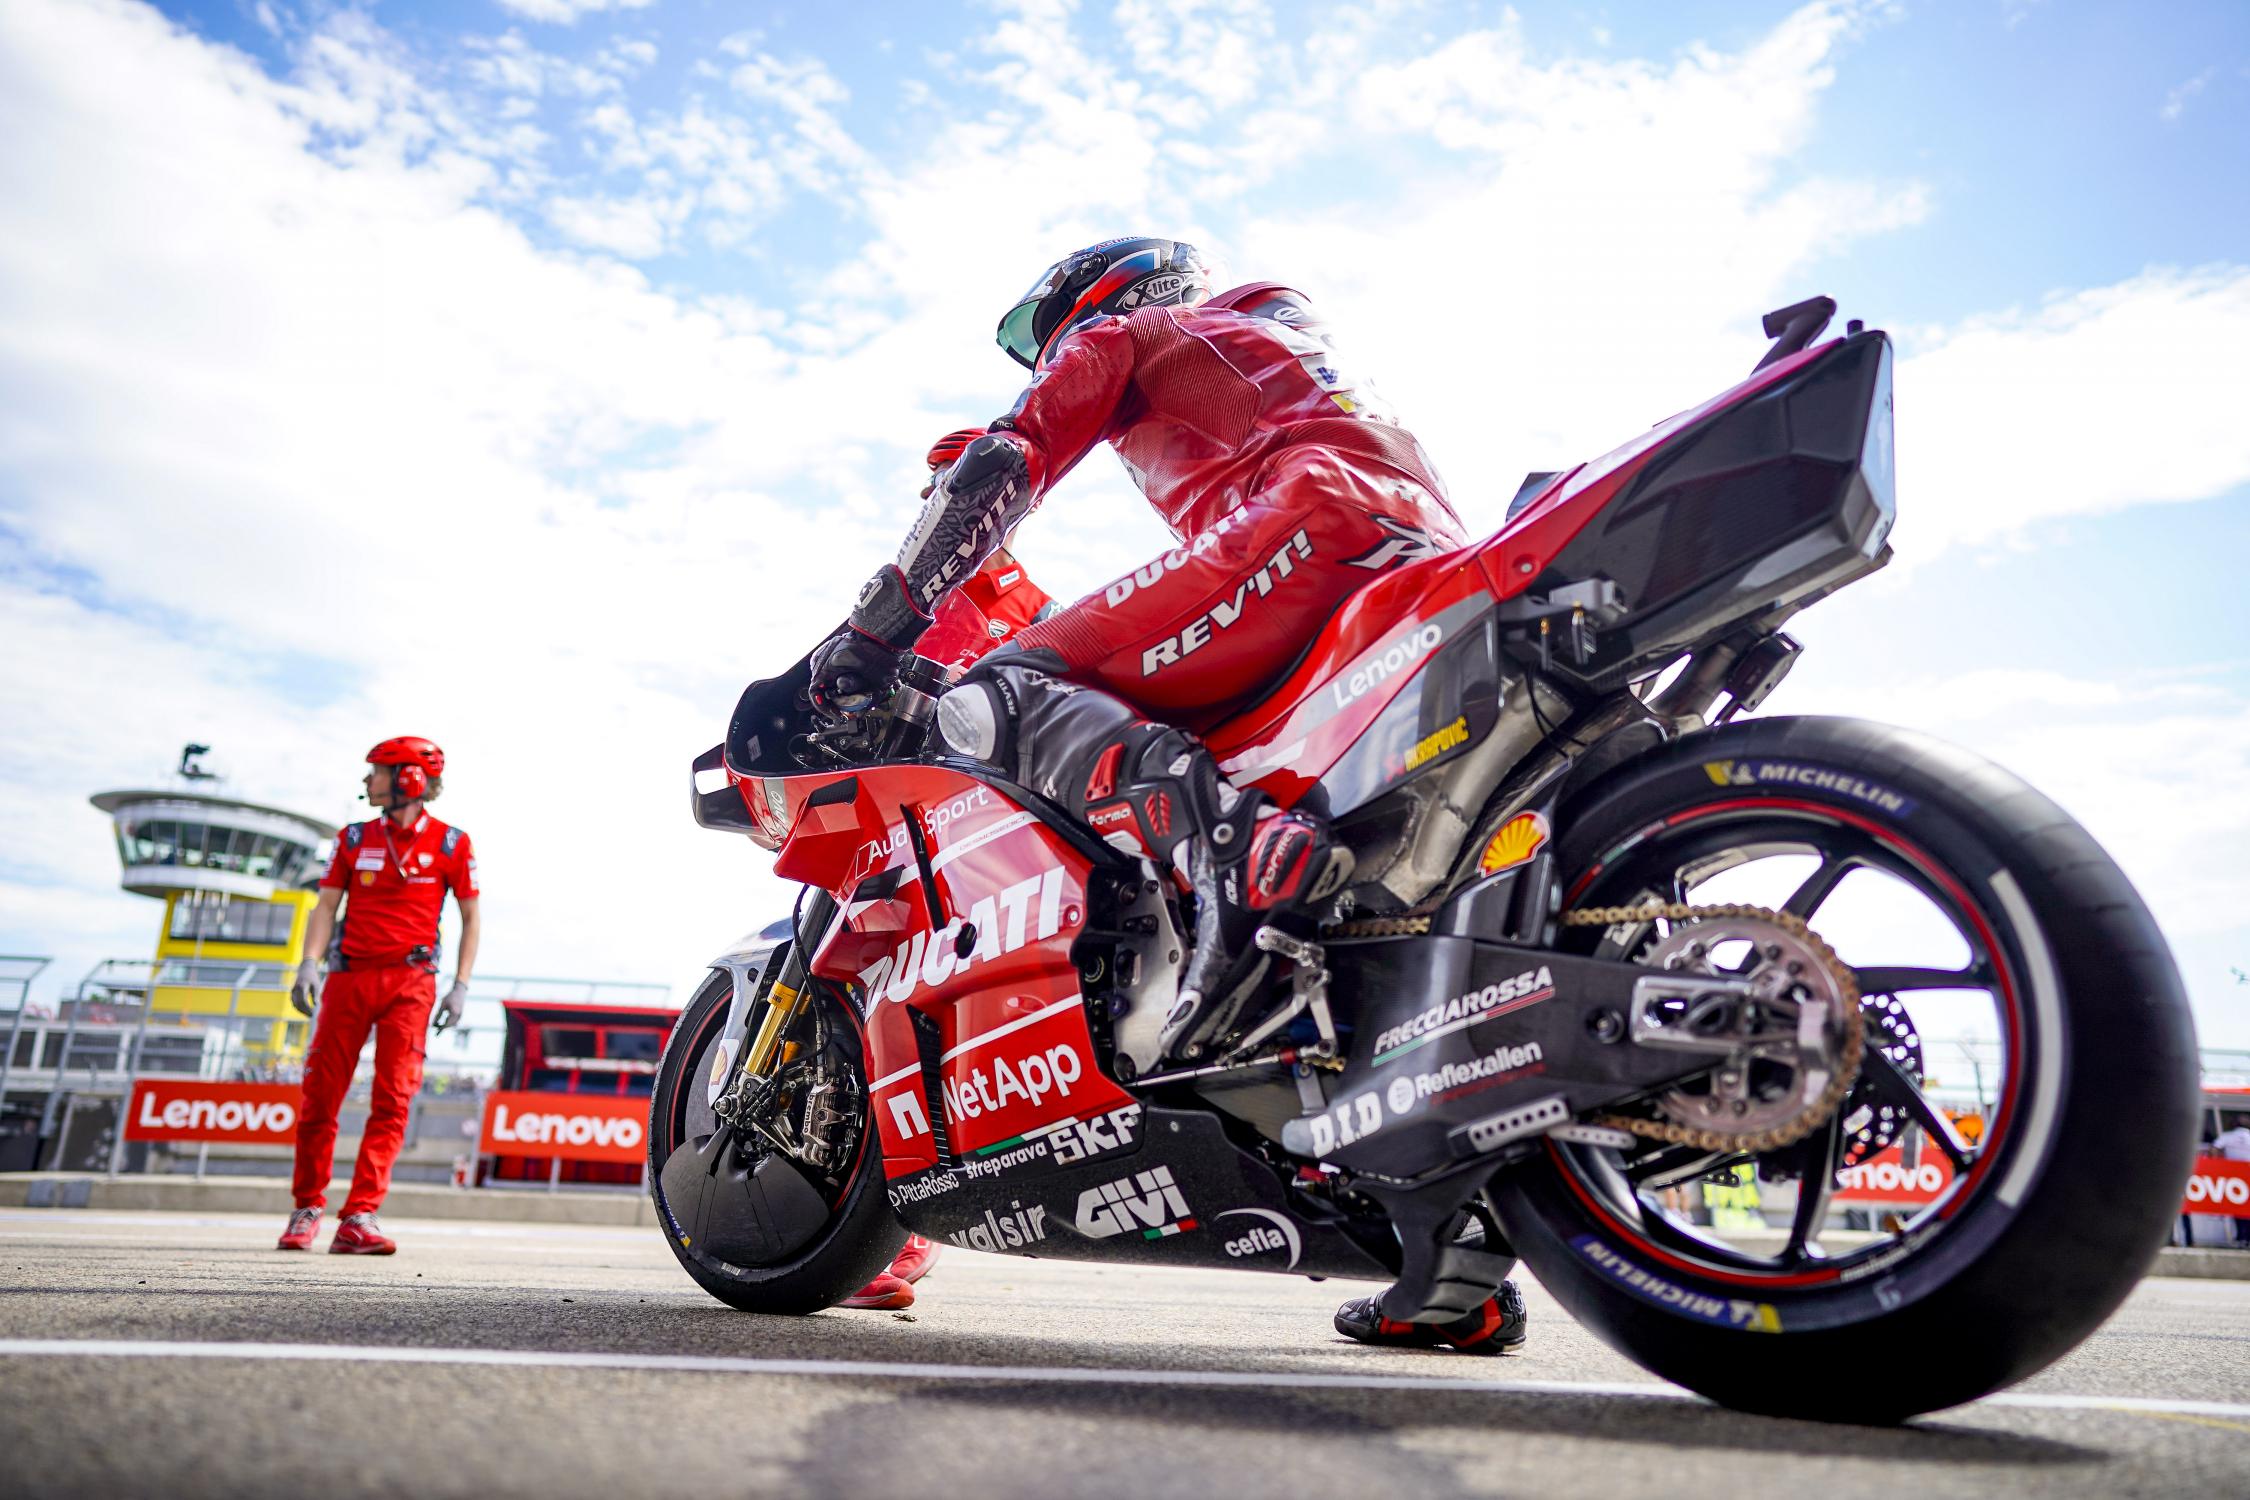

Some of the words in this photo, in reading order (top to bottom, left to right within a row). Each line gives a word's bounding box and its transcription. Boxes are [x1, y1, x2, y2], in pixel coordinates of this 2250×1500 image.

[1131, 277, 1180, 308] X-lite
[1105, 505, 1249, 609] DUCATI
[1332, 624, 1443, 709] Lenovo
[924, 785, 989, 837] Sport
[1758, 763, 1905, 812] MICHELIN
[857, 865, 1066, 1023] DUCATI
[1374, 965, 1553, 1055] FRECCIAROSSA
[940, 1043, 1082, 1126] NetApp
[1414, 1041, 1543, 1099] Reflexallen
[139, 1091, 296, 1133] Lenovo
[492, 1104, 643, 1148] Lenovo
[803, 1092, 816, 1134] brembo
[1047, 1103, 1142, 1166] SKF
[965, 1140, 1048, 1180] streparava
[1075, 1164, 1191, 1239] GIVI
[2185, 1174, 2249, 1205] ovo
[949, 1200, 1046, 1253] valsir
[1224, 1228, 1287, 1258] cefla
[1583, 1241, 1725, 1318] MICHELIN
